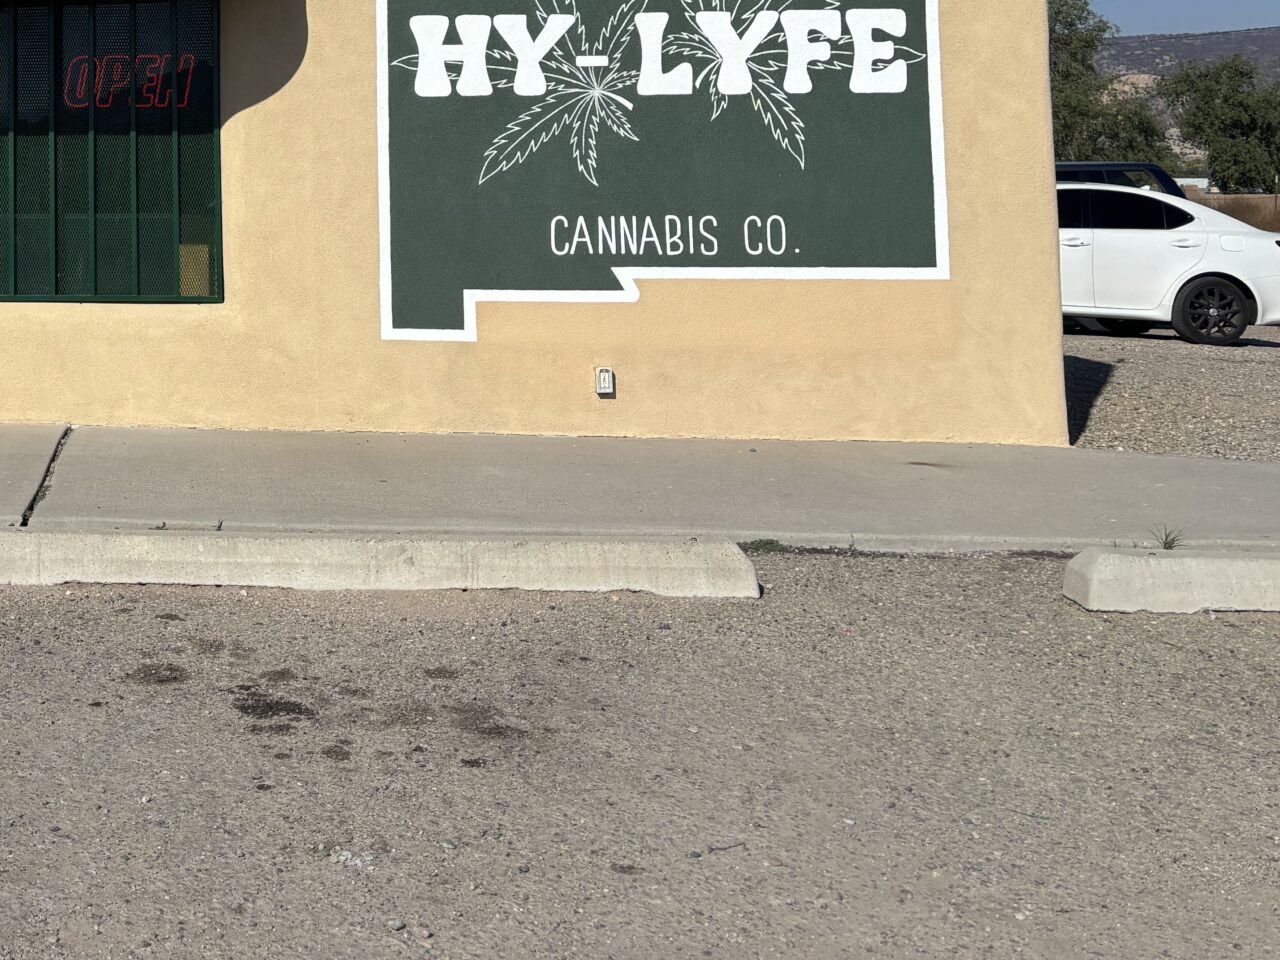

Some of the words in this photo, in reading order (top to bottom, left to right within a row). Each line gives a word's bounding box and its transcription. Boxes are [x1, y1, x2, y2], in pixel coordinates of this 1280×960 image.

[409, 8, 908, 97] HY-LYFE
[63, 53, 196, 108] OPEN
[550, 214, 719, 256] CANNABIS
[743, 215, 801, 256] CO.
